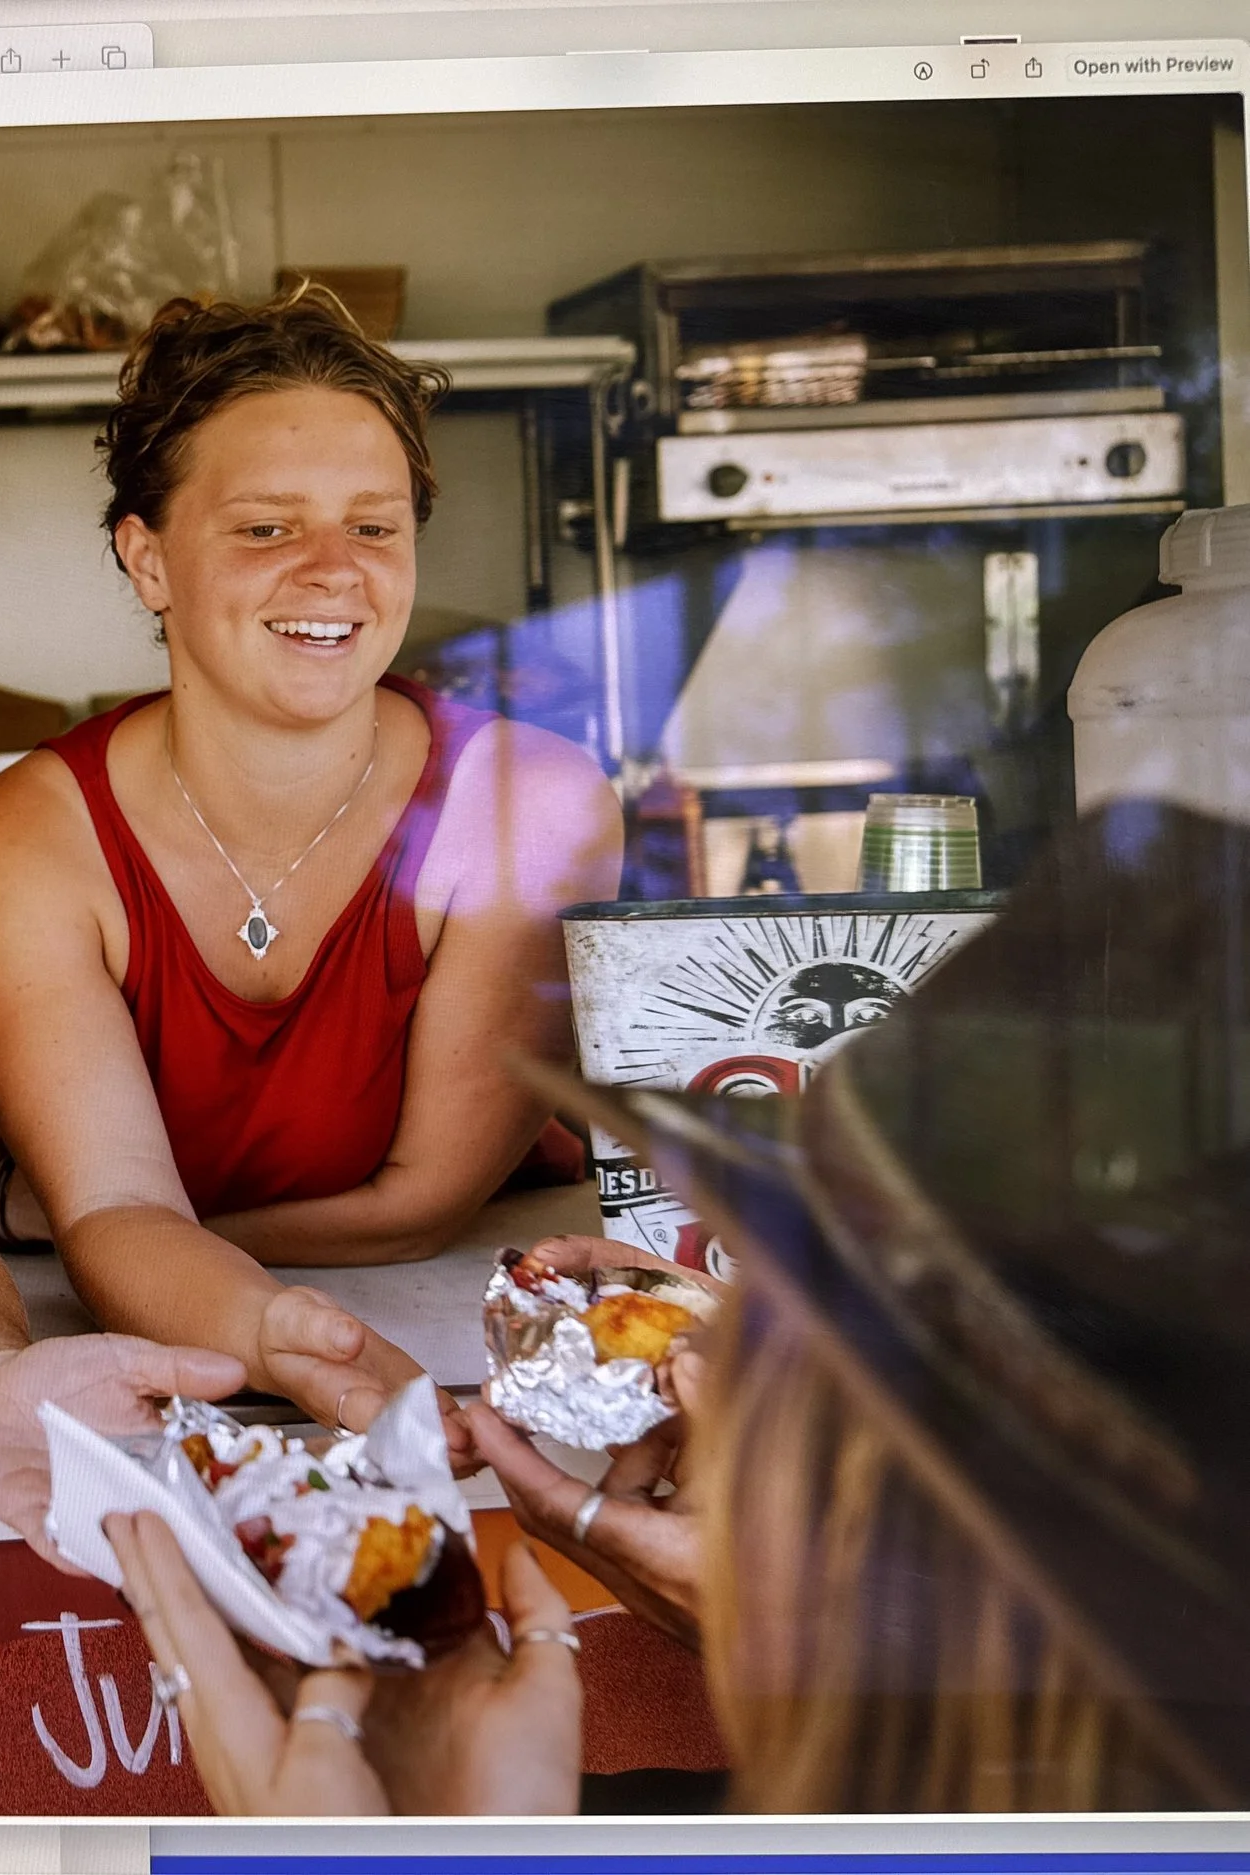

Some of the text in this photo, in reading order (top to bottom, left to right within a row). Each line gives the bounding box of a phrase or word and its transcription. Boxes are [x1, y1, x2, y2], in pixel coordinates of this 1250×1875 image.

[1074, 55, 1233, 77] Open with Preview
